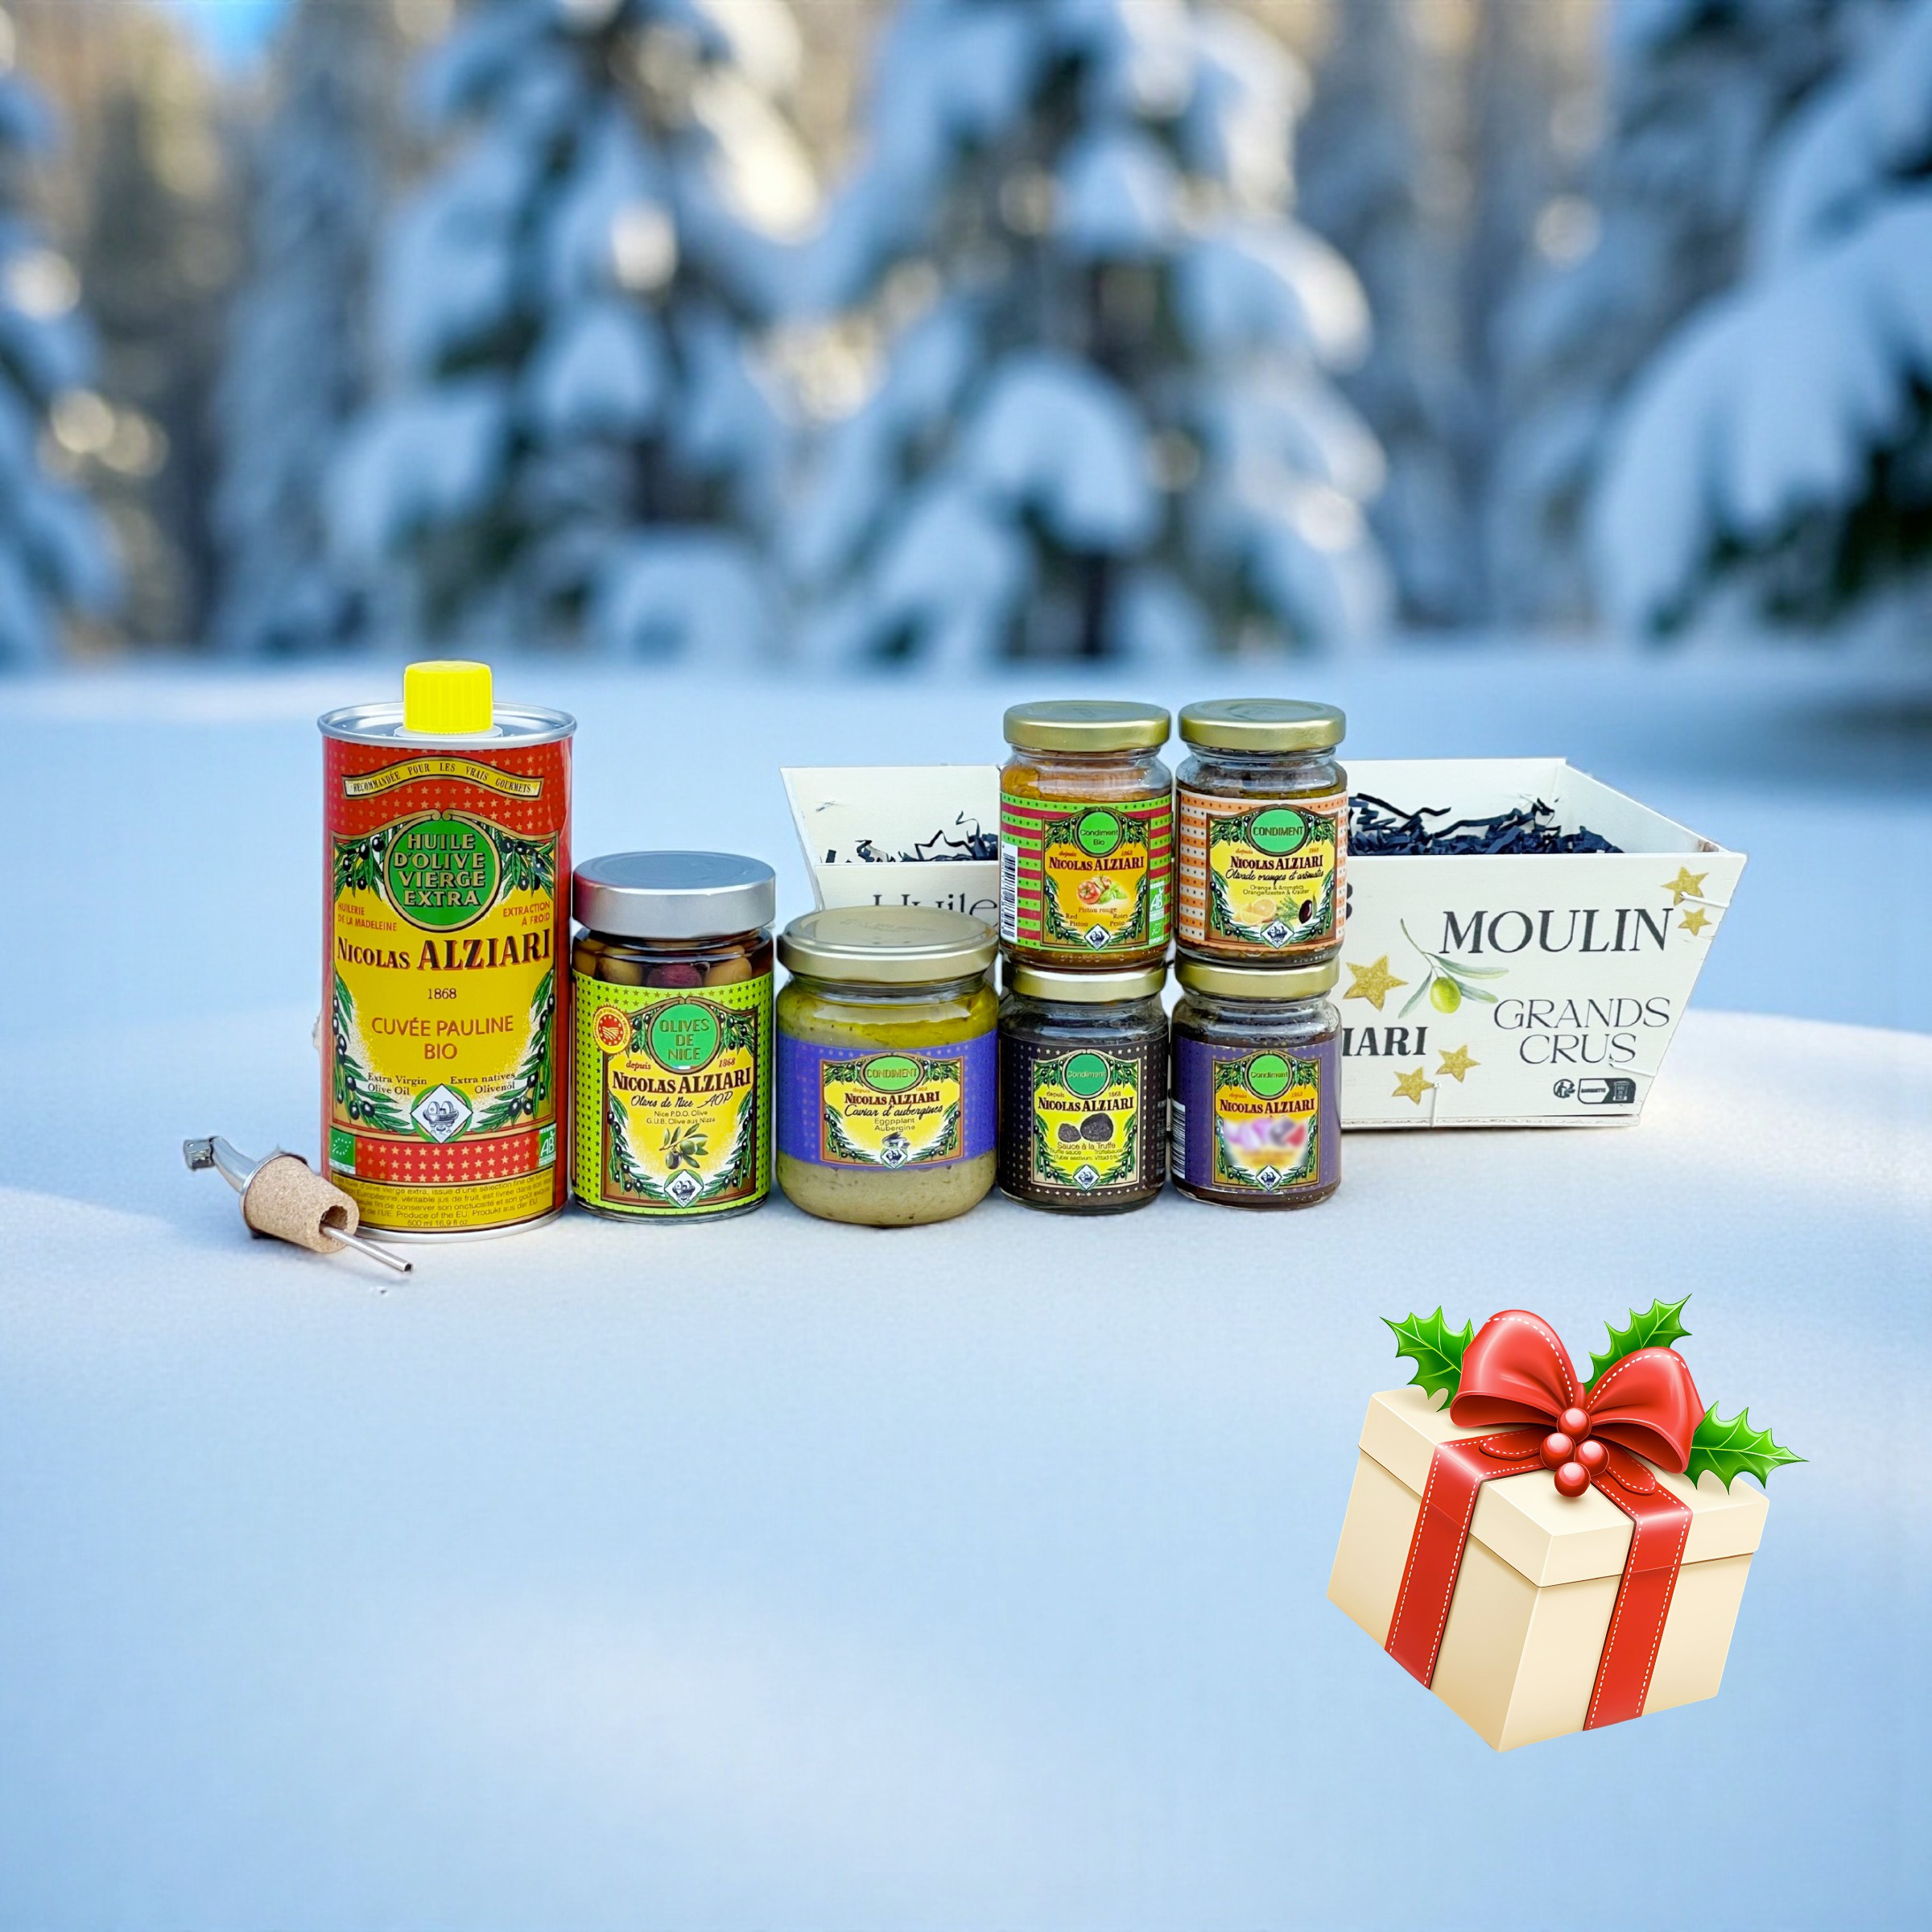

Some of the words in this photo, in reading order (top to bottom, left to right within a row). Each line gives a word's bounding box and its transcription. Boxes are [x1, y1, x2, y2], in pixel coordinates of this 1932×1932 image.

[353, 771, 400, 791] RECOMMANDÉE
[408, 764, 430, 774] POUR
[440, 762, 455, 771] LES
[466, 766, 488, 781] VRAIS
[496, 778, 530, 793] GOURMETS
[1253, 827, 1304, 836] CONDIMENT
[407, 834, 475, 850] HUILE
[394, 852, 485, 869] D'OLIVE
[1050, 857, 1092, 870] NICOLAS
[1094, 857, 1144, 870] ALZIARI
[1231, 856, 1274, 869] NICOLAS
[1275, 856, 1323, 869] ALZIARI
[398, 872, 485, 888] VIERGE
[404, 890, 481, 907] EXTRA
[338, 903, 365, 916] HUILERIE
[503, 902, 550, 918] EXTRACTION
[338, 914, 345, 923] DE
[346, 916, 353, 925] LA
[355, 917, 396, 931] MADELEINE
[530, 913, 550, 925] FROID
[1439, 907, 1674, 954] MOULIN
[337, 936, 411, 969] NICOLAS
[417, 928, 551, 970] ALZIARI
[427, 989, 456, 999] 1868
[1493, 997, 1671, 1030] GRANDS
[372, 1018, 430, 1036] CUVÉE
[436, 1016, 514, 1036] PAULINE
[659, 1019, 709, 1033] OLIVES
[675, 1034, 693, 1046] DE
[1342, 1026, 1429, 1057] IARI
[424, 1043, 457, 1059] BIO
[668, 1048, 700, 1060] NICE
[1520, 1033, 1637, 1064] CRUS
[626, 1060, 651, 1071] depuis
[718, 1059, 735, 1068] 1868
[368, 1072, 392, 1084] Extra
[395, 1075, 427, 1086] Virgin
[450, 1075, 478, 1084] Extra
[481, 1072, 515, 1083] natives
[613, 1071, 675, 1093] NICOLAS
[678, 1067, 751, 1094] ALZIARI
[866, 1068, 919, 1079] CONDIMENT
[368, 1084, 392, 1094] Olive
[394, 1085, 410, 1096] Oil
[475, 1082, 515, 1093] Olivenöl
[661, 1096, 672, 1108] de
[844, 1093, 887, 1104] NICOLAS
[890, 1092, 939, 1105] ALZIARI
[1038, 1097, 1080, 1111] NICOLAS
[1082, 1096, 1135, 1112] ALZIARI
[844, 1104, 879, 1117] Caviar
[1220, 1099, 1262, 1113] NICOLAS
[1265, 1098, 1315, 1114] ALZIARI
